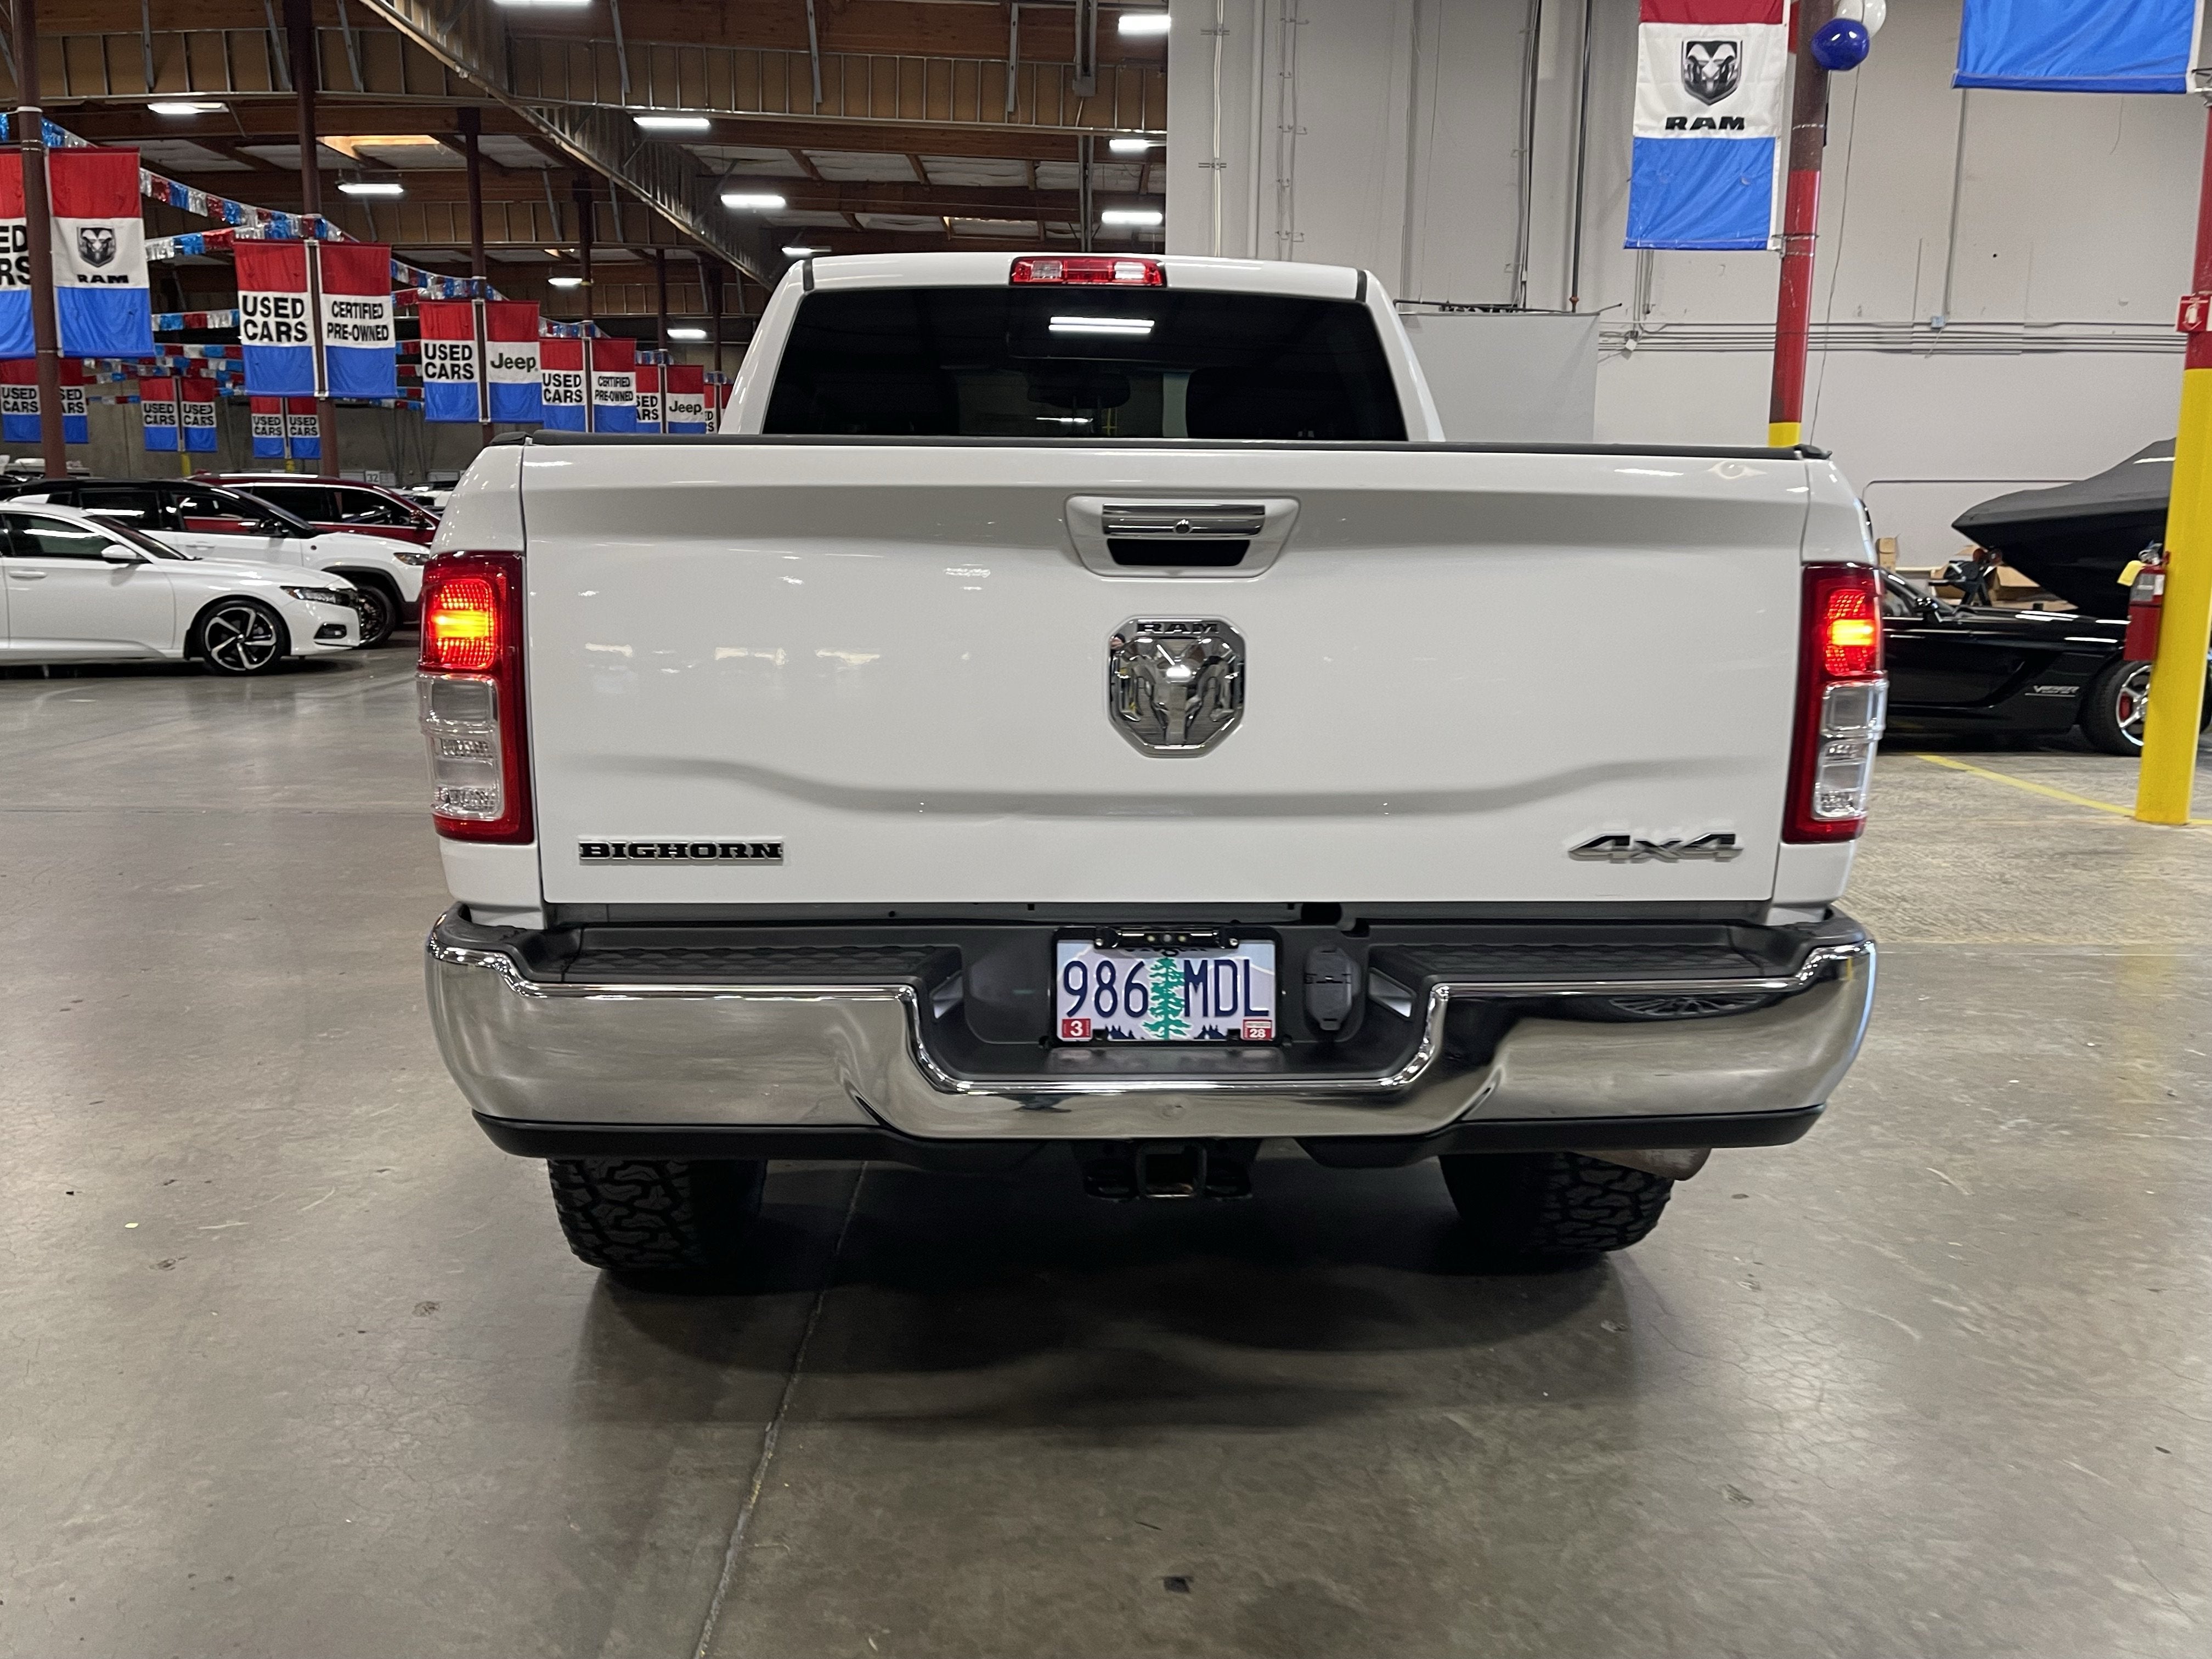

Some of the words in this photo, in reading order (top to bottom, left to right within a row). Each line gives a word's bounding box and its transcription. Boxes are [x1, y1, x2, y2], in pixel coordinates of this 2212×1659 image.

[1665, 116, 1745, 131] RAM
[0, 225, 27, 253] ED
[0, 256, 30, 285] RS
[77, 274, 129, 284] RAM
[242, 295, 304, 319] USED
[332, 301, 383, 319] CERTIFIED
[244, 319, 307, 342] CARS
[327, 322, 389, 341] PRE-OWNED
[424, 343, 472, 361] USED
[490, 353, 536, 373] Jeep
[425, 362, 474, 380] CARS
[543, 373, 582, 388] USED
[598, 376, 630, 387] CERTIFIED
[2, 387, 37, 399] USED
[60, 388, 82, 400] SED
[544, 388, 583, 403] CARS
[595, 390, 634, 402] PRE-OWNED
[3, 400, 38, 413] CARS
[144, 403, 174, 414] USED
[184, 404, 212, 414] USED
[669, 400, 702, 415] Jeep
[145, 415, 175, 425] CARS
[184, 415, 213, 425] CARS
[253, 416, 281, 426] USED
[289, 417, 317, 426] USED
[255, 427, 281, 436] CARS
[367, 473, 379, 483] 32
[1136, 623, 1219, 634] RAM
[579, 841, 783, 860] BIGHORN
[1063, 960, 1149, 1018] 986
[1184, 959, 1269, 1018] MDL
[1070, 1020, 1083, 1036] 3
[1249, 1028, 1266, 1038] 28
